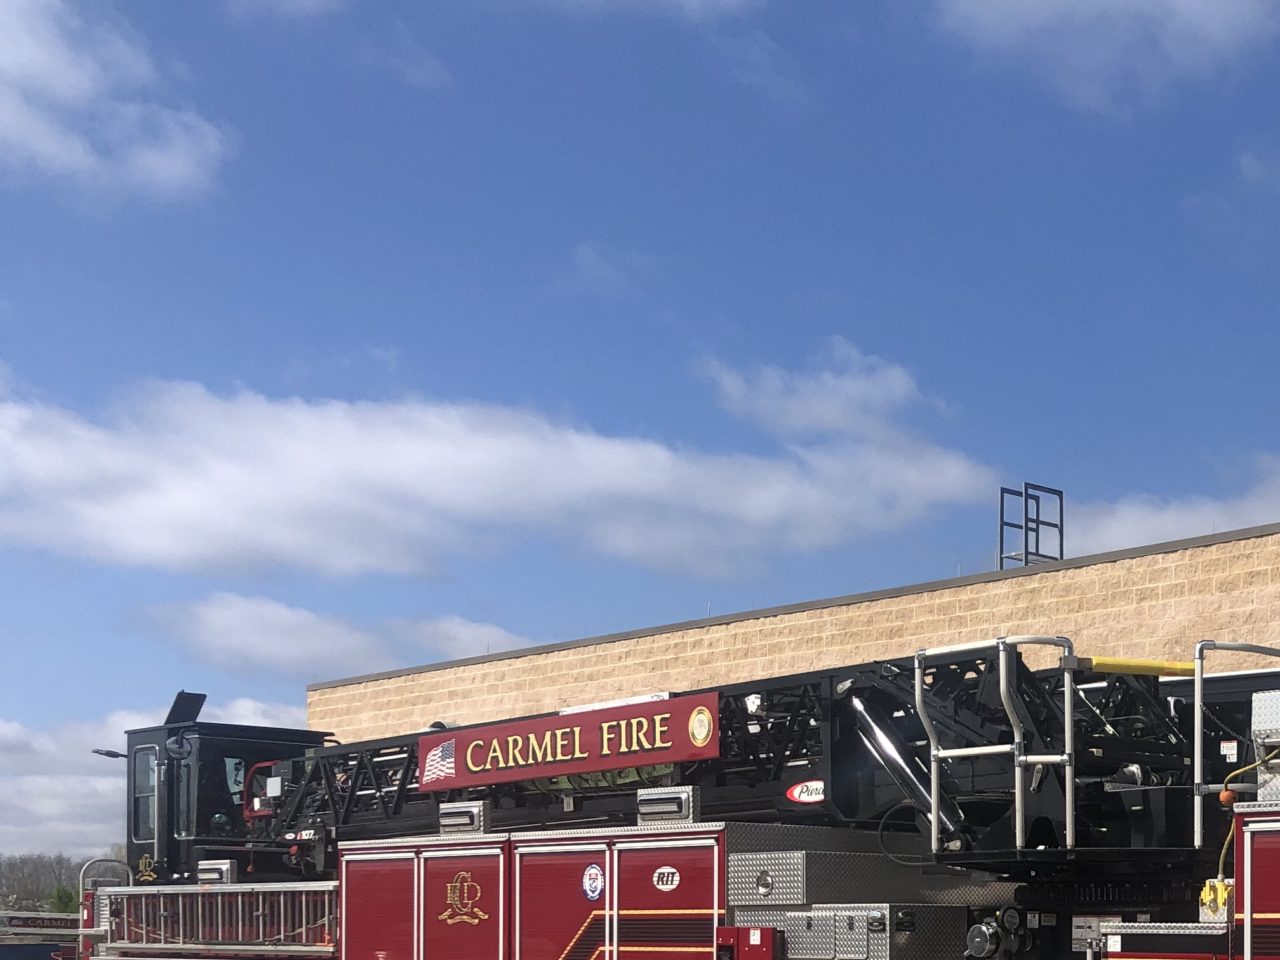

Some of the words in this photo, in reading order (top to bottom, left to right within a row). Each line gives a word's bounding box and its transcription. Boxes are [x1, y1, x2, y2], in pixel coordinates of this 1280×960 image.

[465, 725, 588, 772] CARMEL
[601, 712, 673, 755] FIRE
[656, 871, 677, 886] RIT
